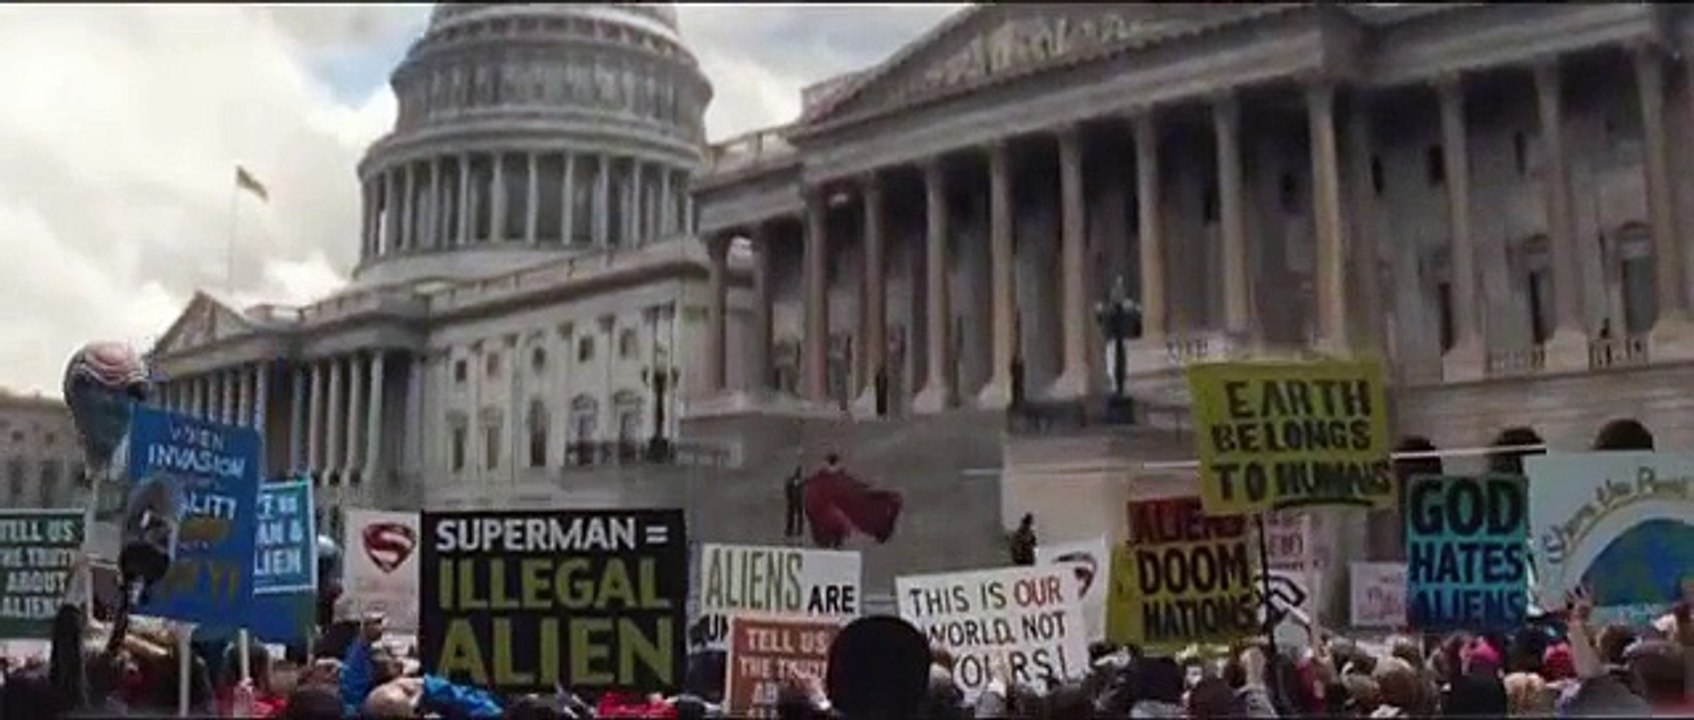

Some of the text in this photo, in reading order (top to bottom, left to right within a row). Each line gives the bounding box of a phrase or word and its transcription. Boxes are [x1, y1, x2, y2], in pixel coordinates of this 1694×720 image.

[1225, 378, 1371, 419] EARTH
[1211, 420, 1371, 452] BELONGS
[1210, 461, 1267, 502] TO
[1410, 478, 1523, 536] GOD
[435, 517, 637, 552] SUPERMAN
[438, 555, 673, 610] ILLEGAL
[706, 548, 856, 614] ALIENS ARE
[1136, 545, 1250, 591] DOOM
[1410, 540, 1524, 585] HATES
[909, 576, 1064, 617] THIS IS OUR
[1143, 592, 1258, 642] NATIONS
[747, 627, 827, 654] TELL US
[1021, 610, 1065, 641] NOT
[438, 616, 674, 685] ALIEN
